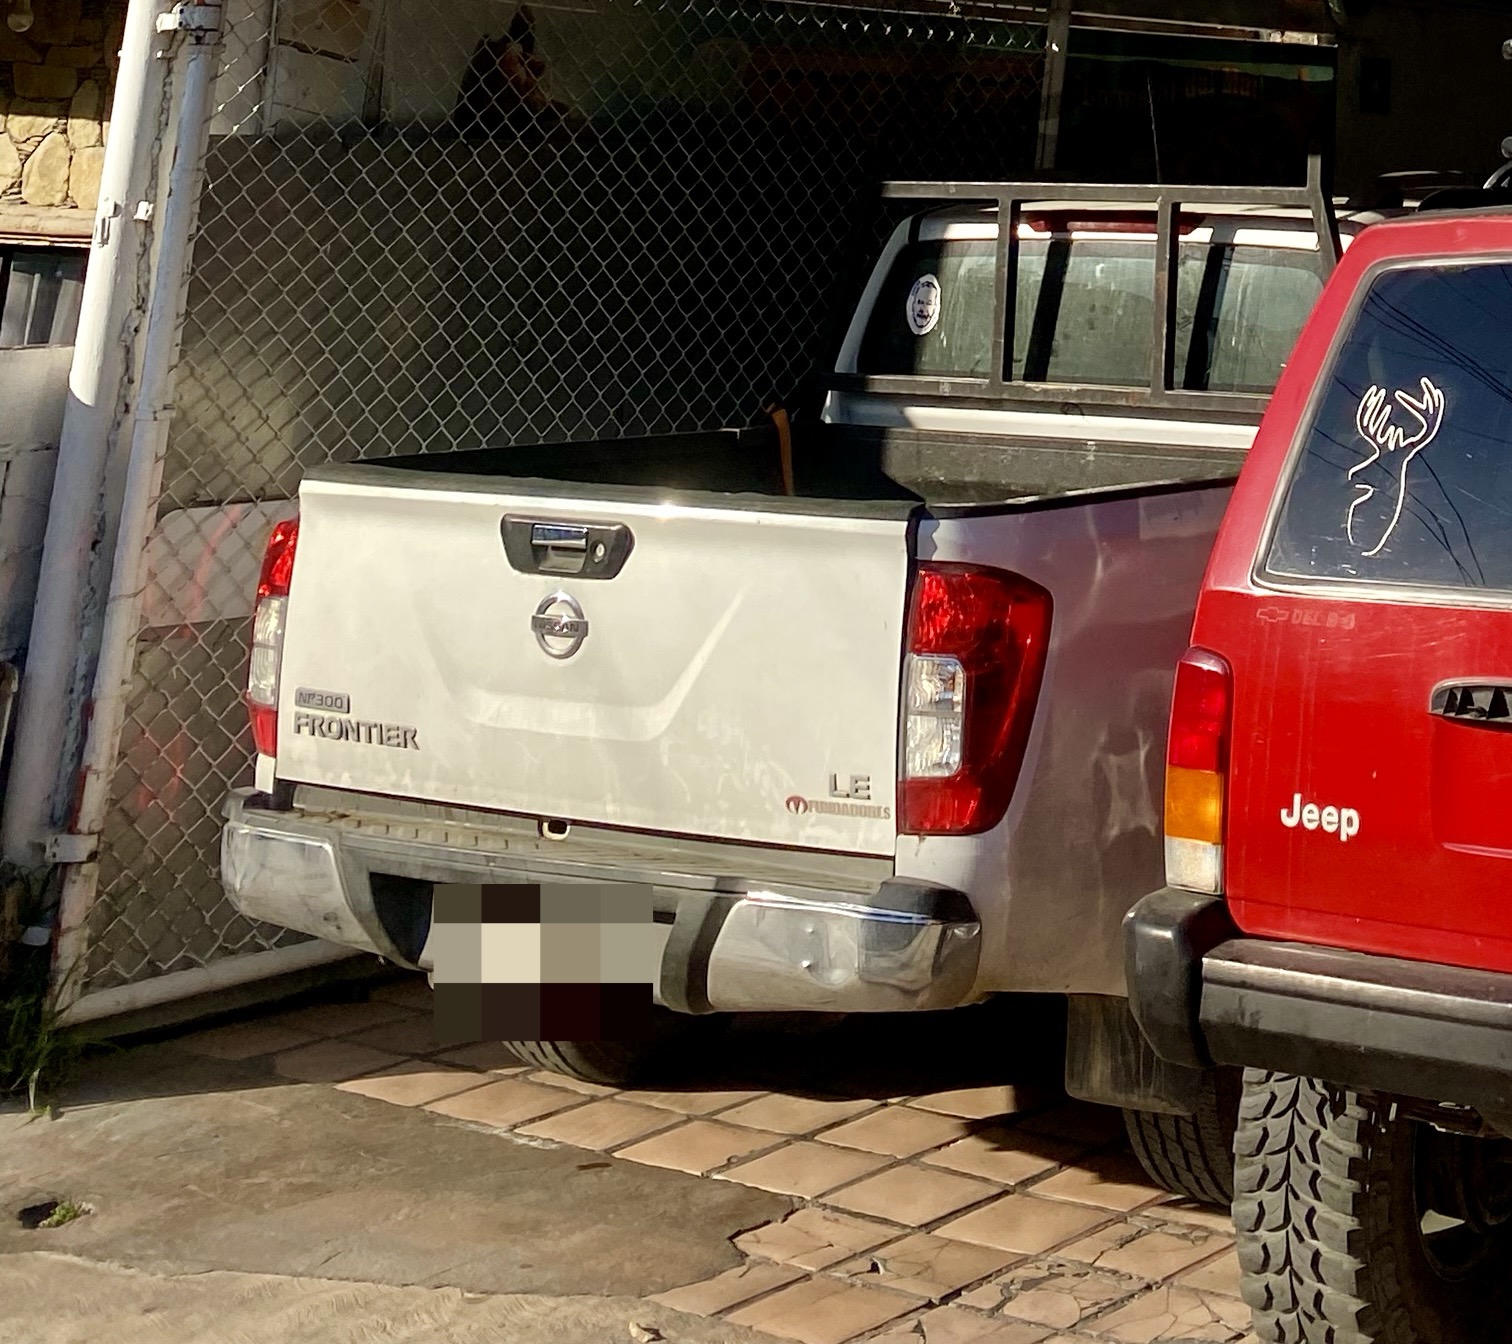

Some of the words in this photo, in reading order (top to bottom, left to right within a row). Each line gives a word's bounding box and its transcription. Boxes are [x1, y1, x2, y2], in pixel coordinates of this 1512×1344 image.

[297, 691, 344, 710] NP300
[293, 710, 420, 750] FRONTIER
[829, 772, 871, 801] LE
[1280, 792, 1360, 842] Jeep
